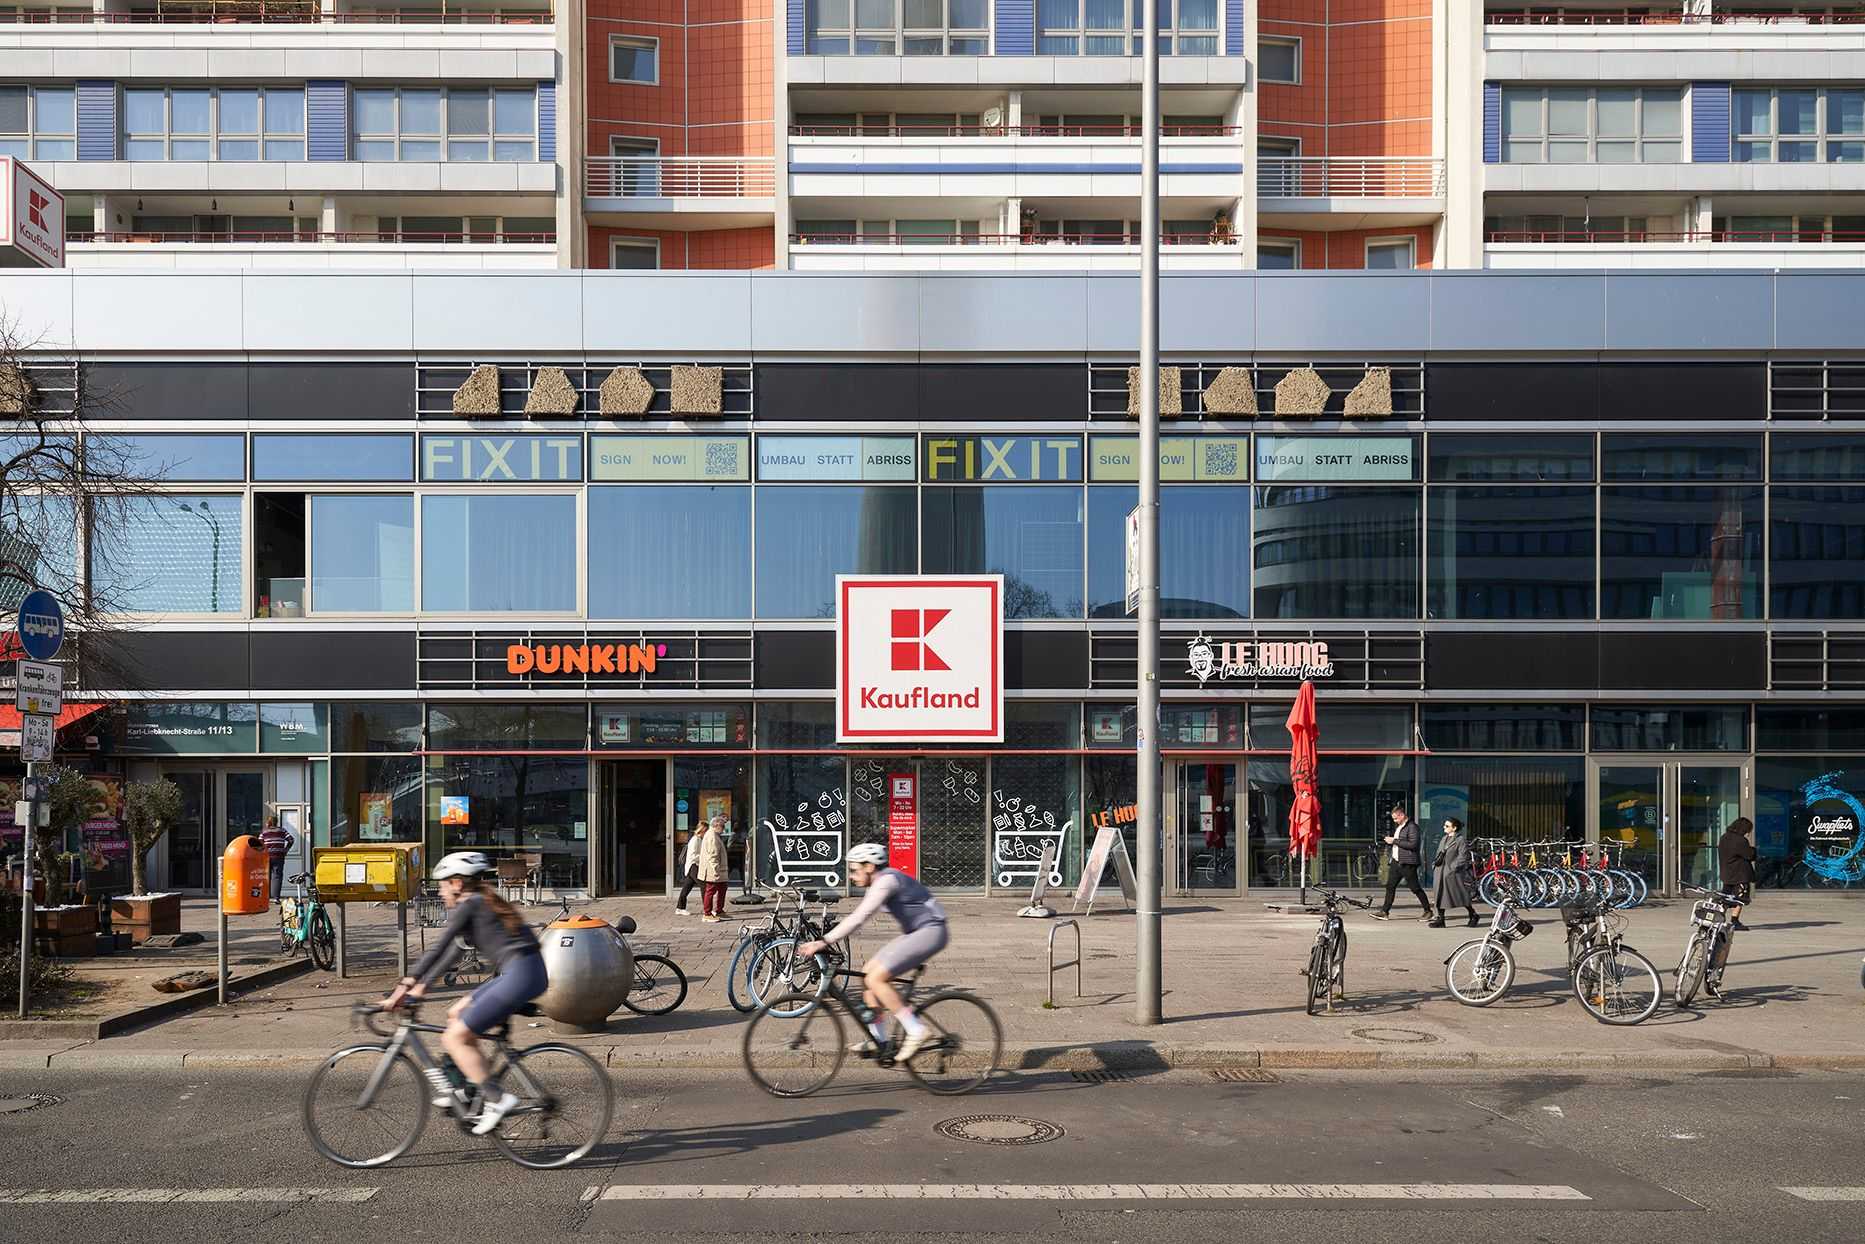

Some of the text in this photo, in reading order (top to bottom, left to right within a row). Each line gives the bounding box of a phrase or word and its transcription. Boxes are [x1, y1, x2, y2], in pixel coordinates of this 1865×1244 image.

[19, 221, 59, 259] Kaufland
[425, 439, 579, 480] FIX IT
[599, 454, 687, 465] SIGN NOW!
[761, 455, 912, 465] UMBAU STATT ABRISS
[928, 439, 1079, 480] FIX IT
[1099, 455, 1185, 465] SIGN OW!
[1259, 455, 1409, 465] UMBAU STATT ABRISS
[507, 644, 667, 674] DUNKIN'
[1221, 642, 1328, 668] LE HUNG
[1220, 662, 1335, 680] fresh asian food
[41, 699, 53, 709] frei
[861, 687, 980, 709] Kaufland
[28, 718, 37, 727] Mo
[208, 726, 233, 735] 11/13
[1091, 805, 1138, 831] LE HU
[1808, 815, 1853, 835] Swapfiets
